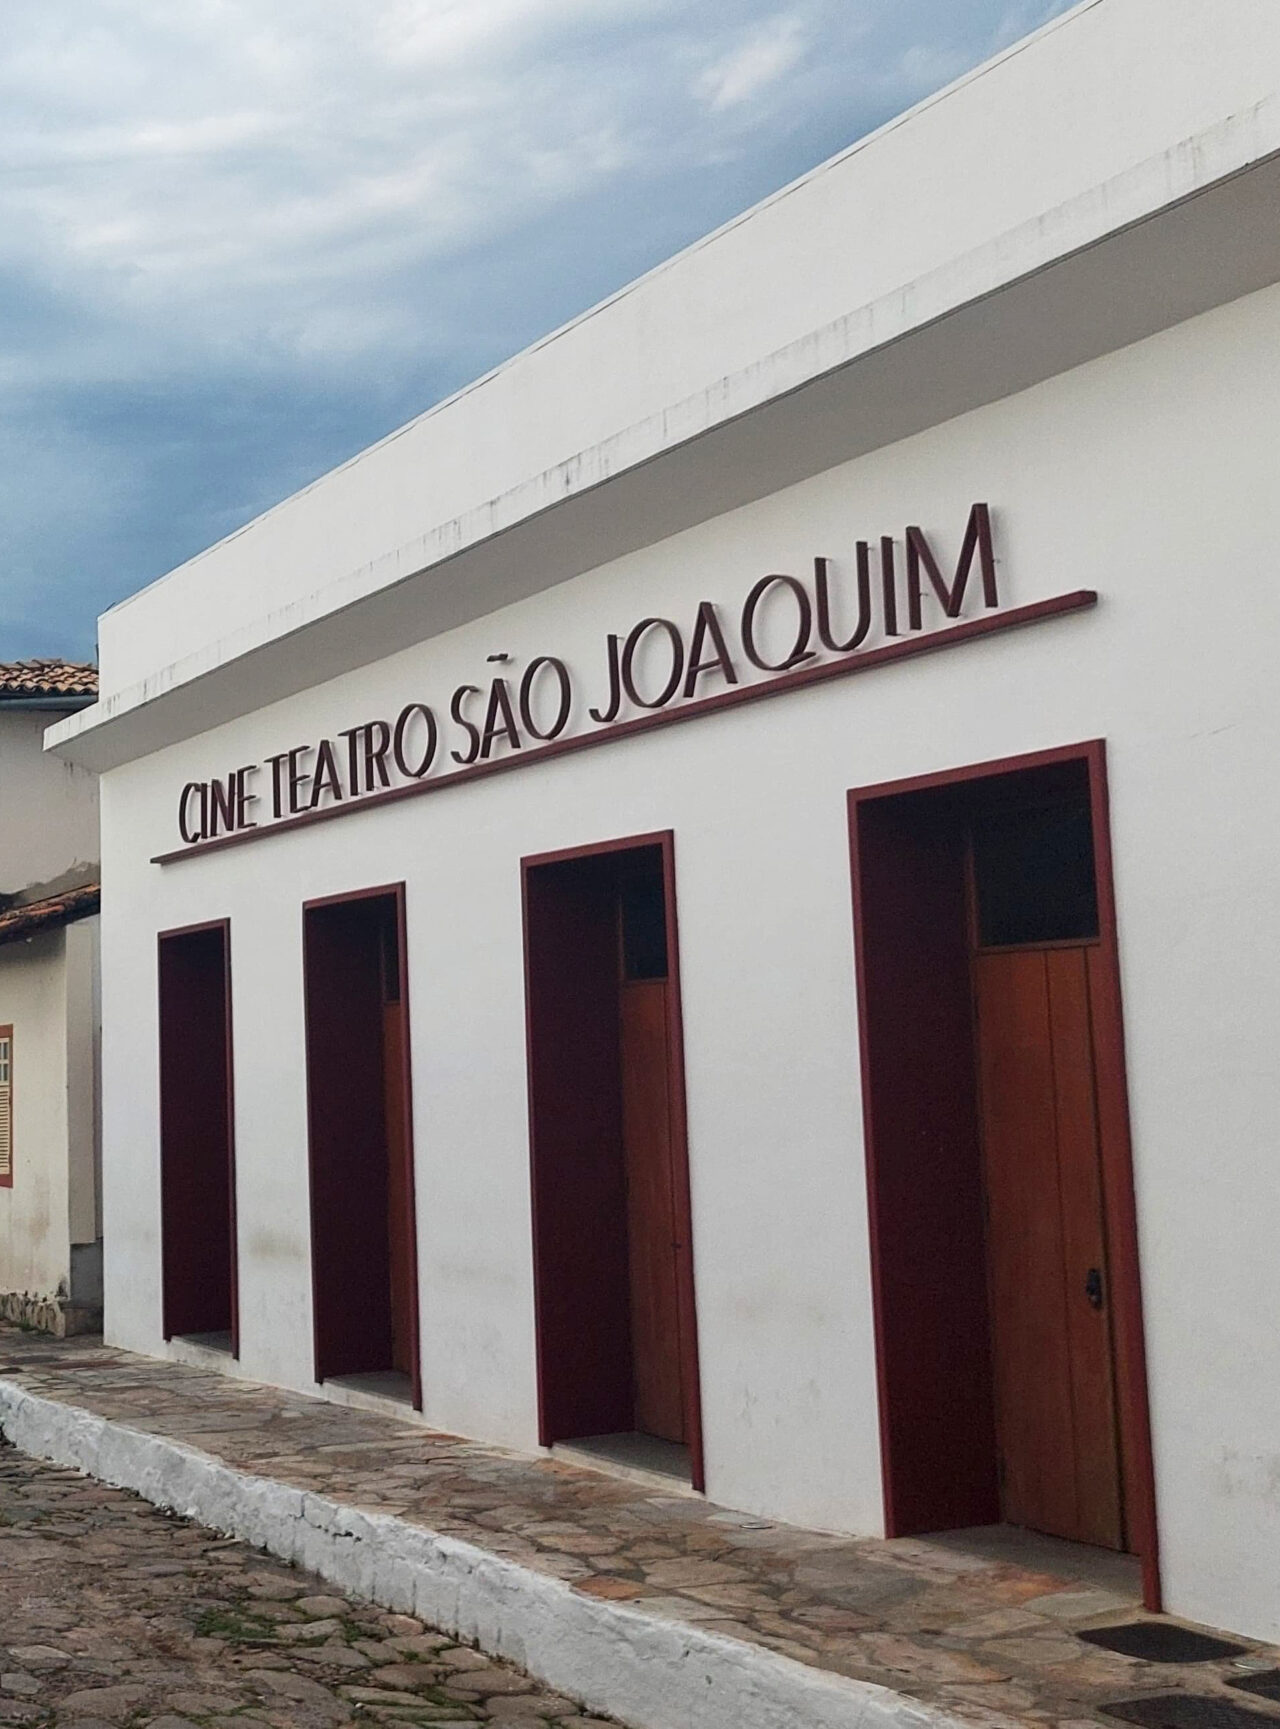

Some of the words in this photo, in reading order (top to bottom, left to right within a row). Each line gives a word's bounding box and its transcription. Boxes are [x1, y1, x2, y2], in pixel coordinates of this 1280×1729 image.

[179, 765, 258, 843] CINE
[264, 703, 438, 818] TEATRO
[450, 652, 572, 764] SÃO
[589, 502, 999, 722] JOAQUIM
